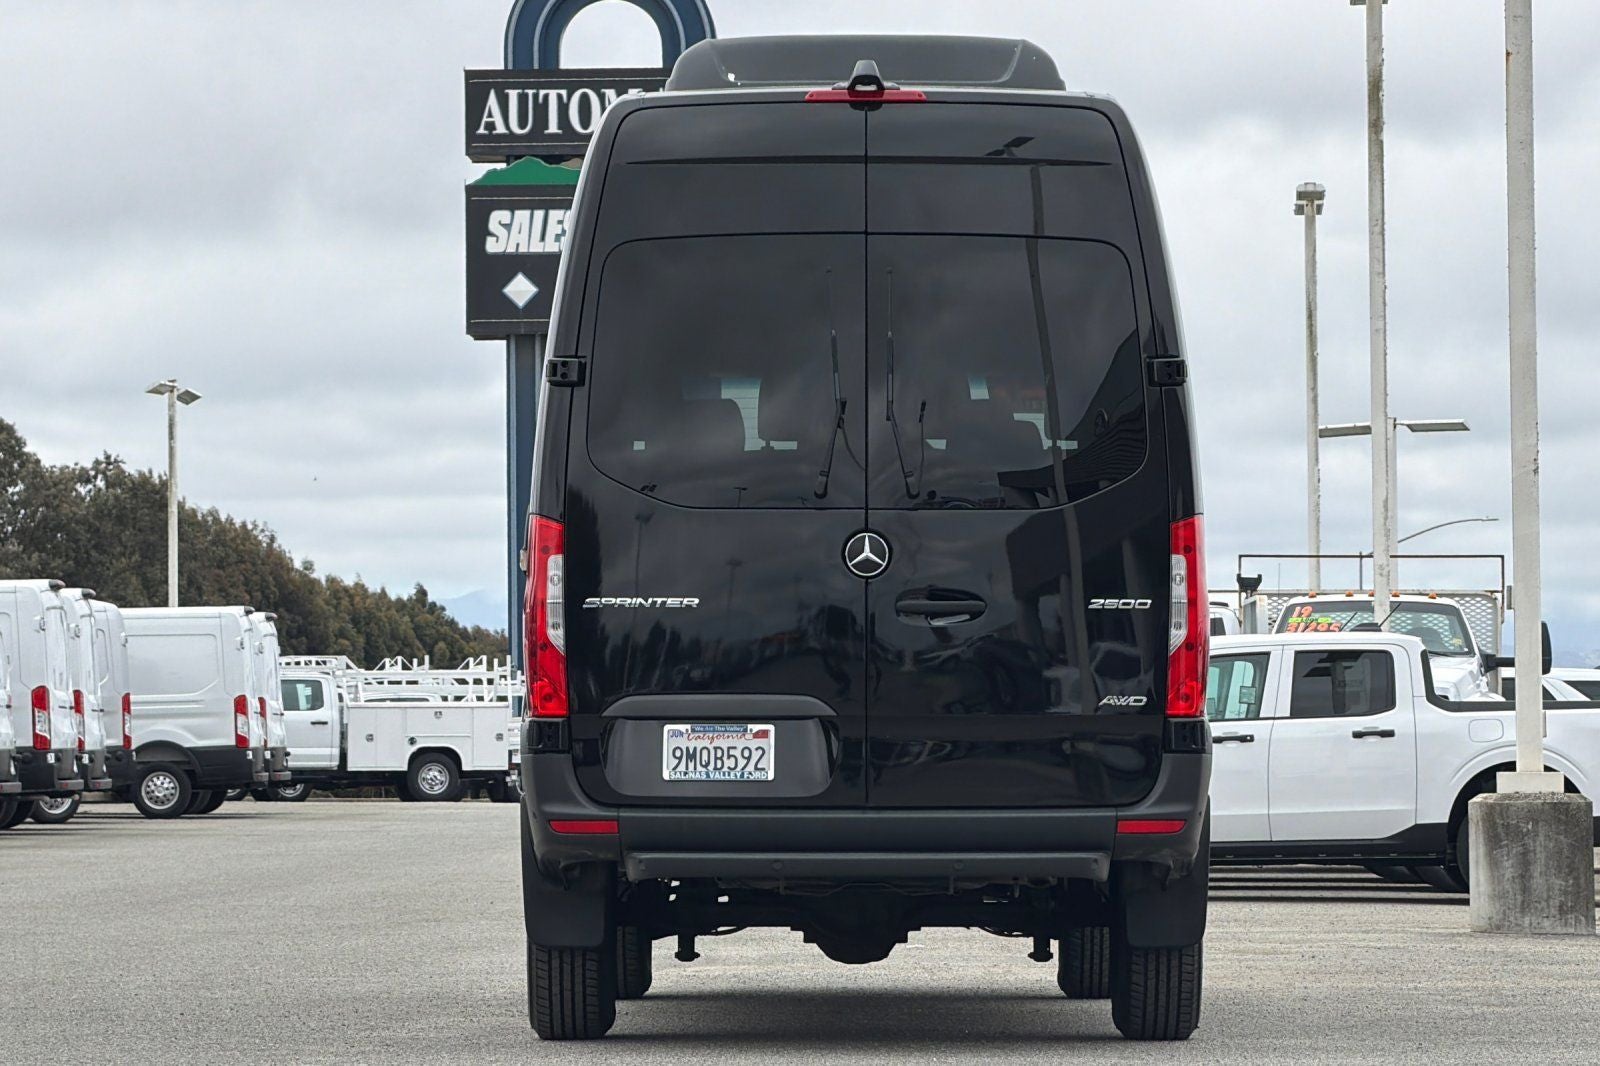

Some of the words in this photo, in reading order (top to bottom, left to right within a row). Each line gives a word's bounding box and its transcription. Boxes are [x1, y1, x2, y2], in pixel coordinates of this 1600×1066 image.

[485, 209, 571, 254] SALE
[583, 597, 699, 608] SPRINTER
[1088, 599, 1152, 609] 2500
[1098, 695, 1147, 706] AWD
[670, 730, 684, 739] JUN
[687, 732, 752, 745] California
[671, 746, 766, 771] 9MQB592
[708, 772, 741, 780] VALLEY
[743, 772, 768, 780] FORD
